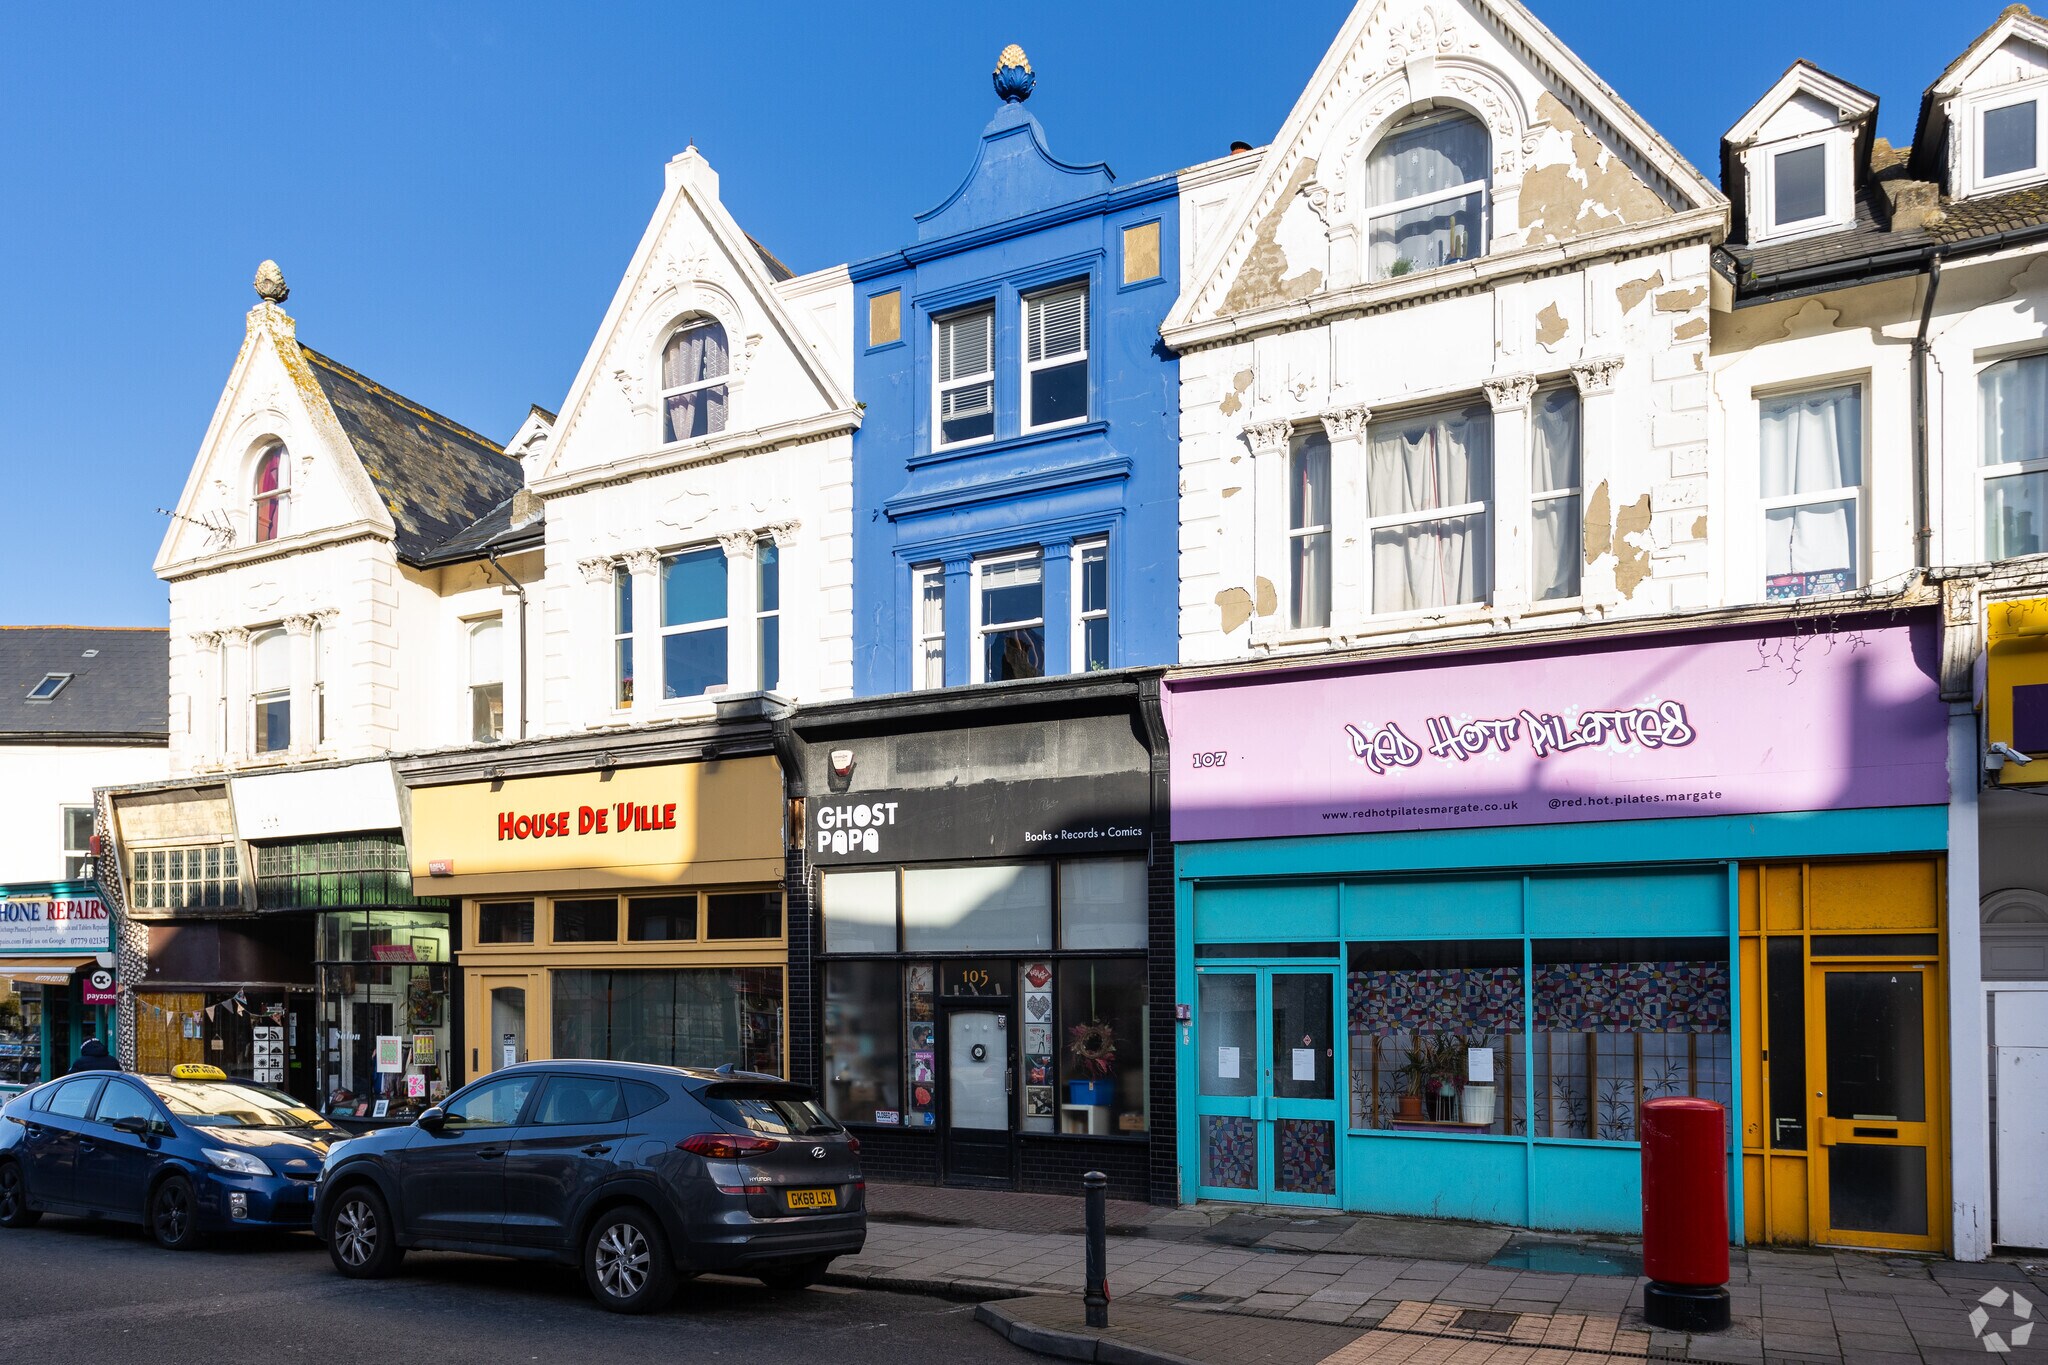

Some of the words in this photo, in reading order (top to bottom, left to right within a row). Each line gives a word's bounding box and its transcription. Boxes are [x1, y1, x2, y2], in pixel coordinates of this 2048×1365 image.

[1192, 751, 1228, 769] 107
[1322, 801, 1518, 819] www.redhotpilatesmargate.co.uk
[1548, 789, 1722, 810] @red.hot.pilates.margate
[817, 802, 898, 829] GHOST
[498, 811, 570, 841] HOUSE
[1025, 830, 1052, 842] Books
[1061, 827, 1098, 840] Records
[1107, 826, 1142, 837] Comics
[817, 828, 879, 855] PAPA
[47, 900, 109, 920] REPAIRS
[49, 936, 66, 947] Google
[71, 937, 88, 945] 07779
[962, 969, 989, 988] 105
[86, 992, 116, 1001] payzone
[791, 1193, 815, 1206] GK68
[816, 1191, 833, 1205] LGX
